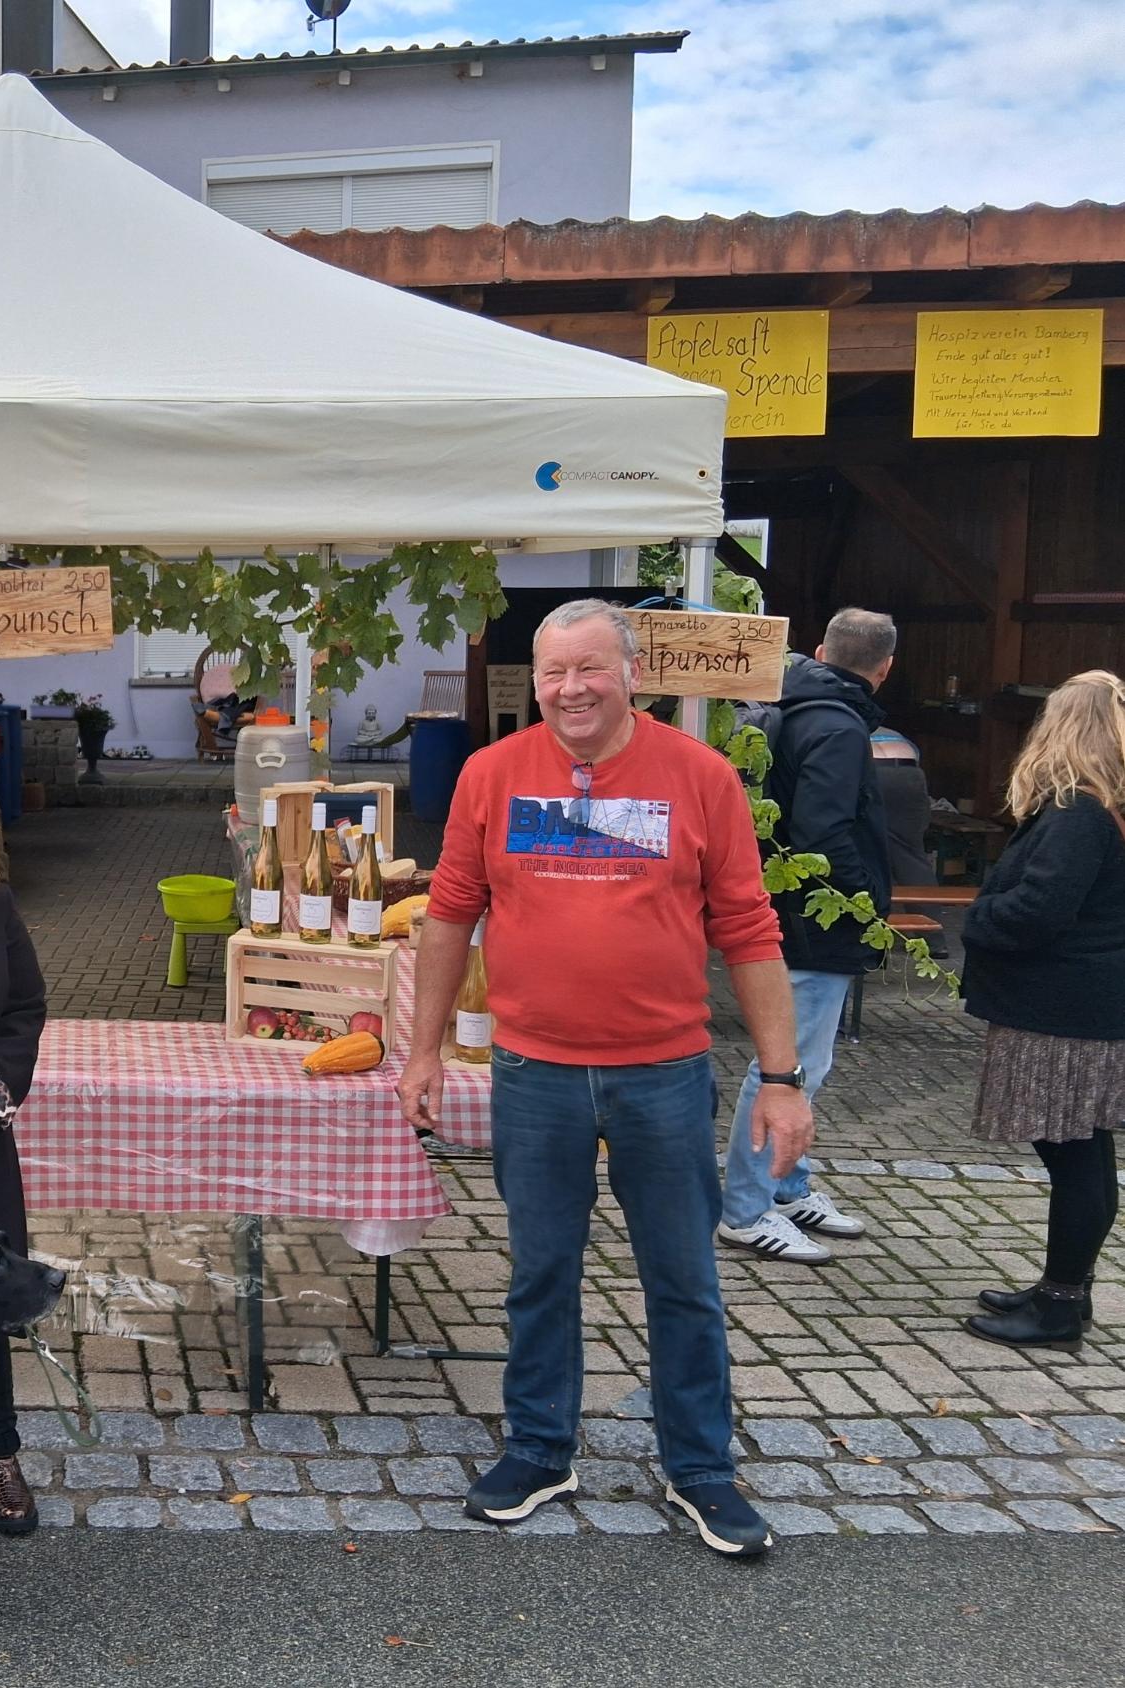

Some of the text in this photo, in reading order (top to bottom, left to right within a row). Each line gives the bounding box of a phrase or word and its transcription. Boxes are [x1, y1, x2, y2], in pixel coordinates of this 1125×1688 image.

[653, 316, 771, 367] Apfelsaft
[928, 323, 1089, 345] Hospizverein Bamberg
[936, 347, 1051, 365] Ende gut alles gut!
[735, 356, 823, 406] Spende
[931, 372, 957, 385] Wir
[63, 570, 107, 592] 2,50
[637, 611, 773, 639] Amaretto 3,50
[518, 858, 648, 877] THE NORTH SEA
